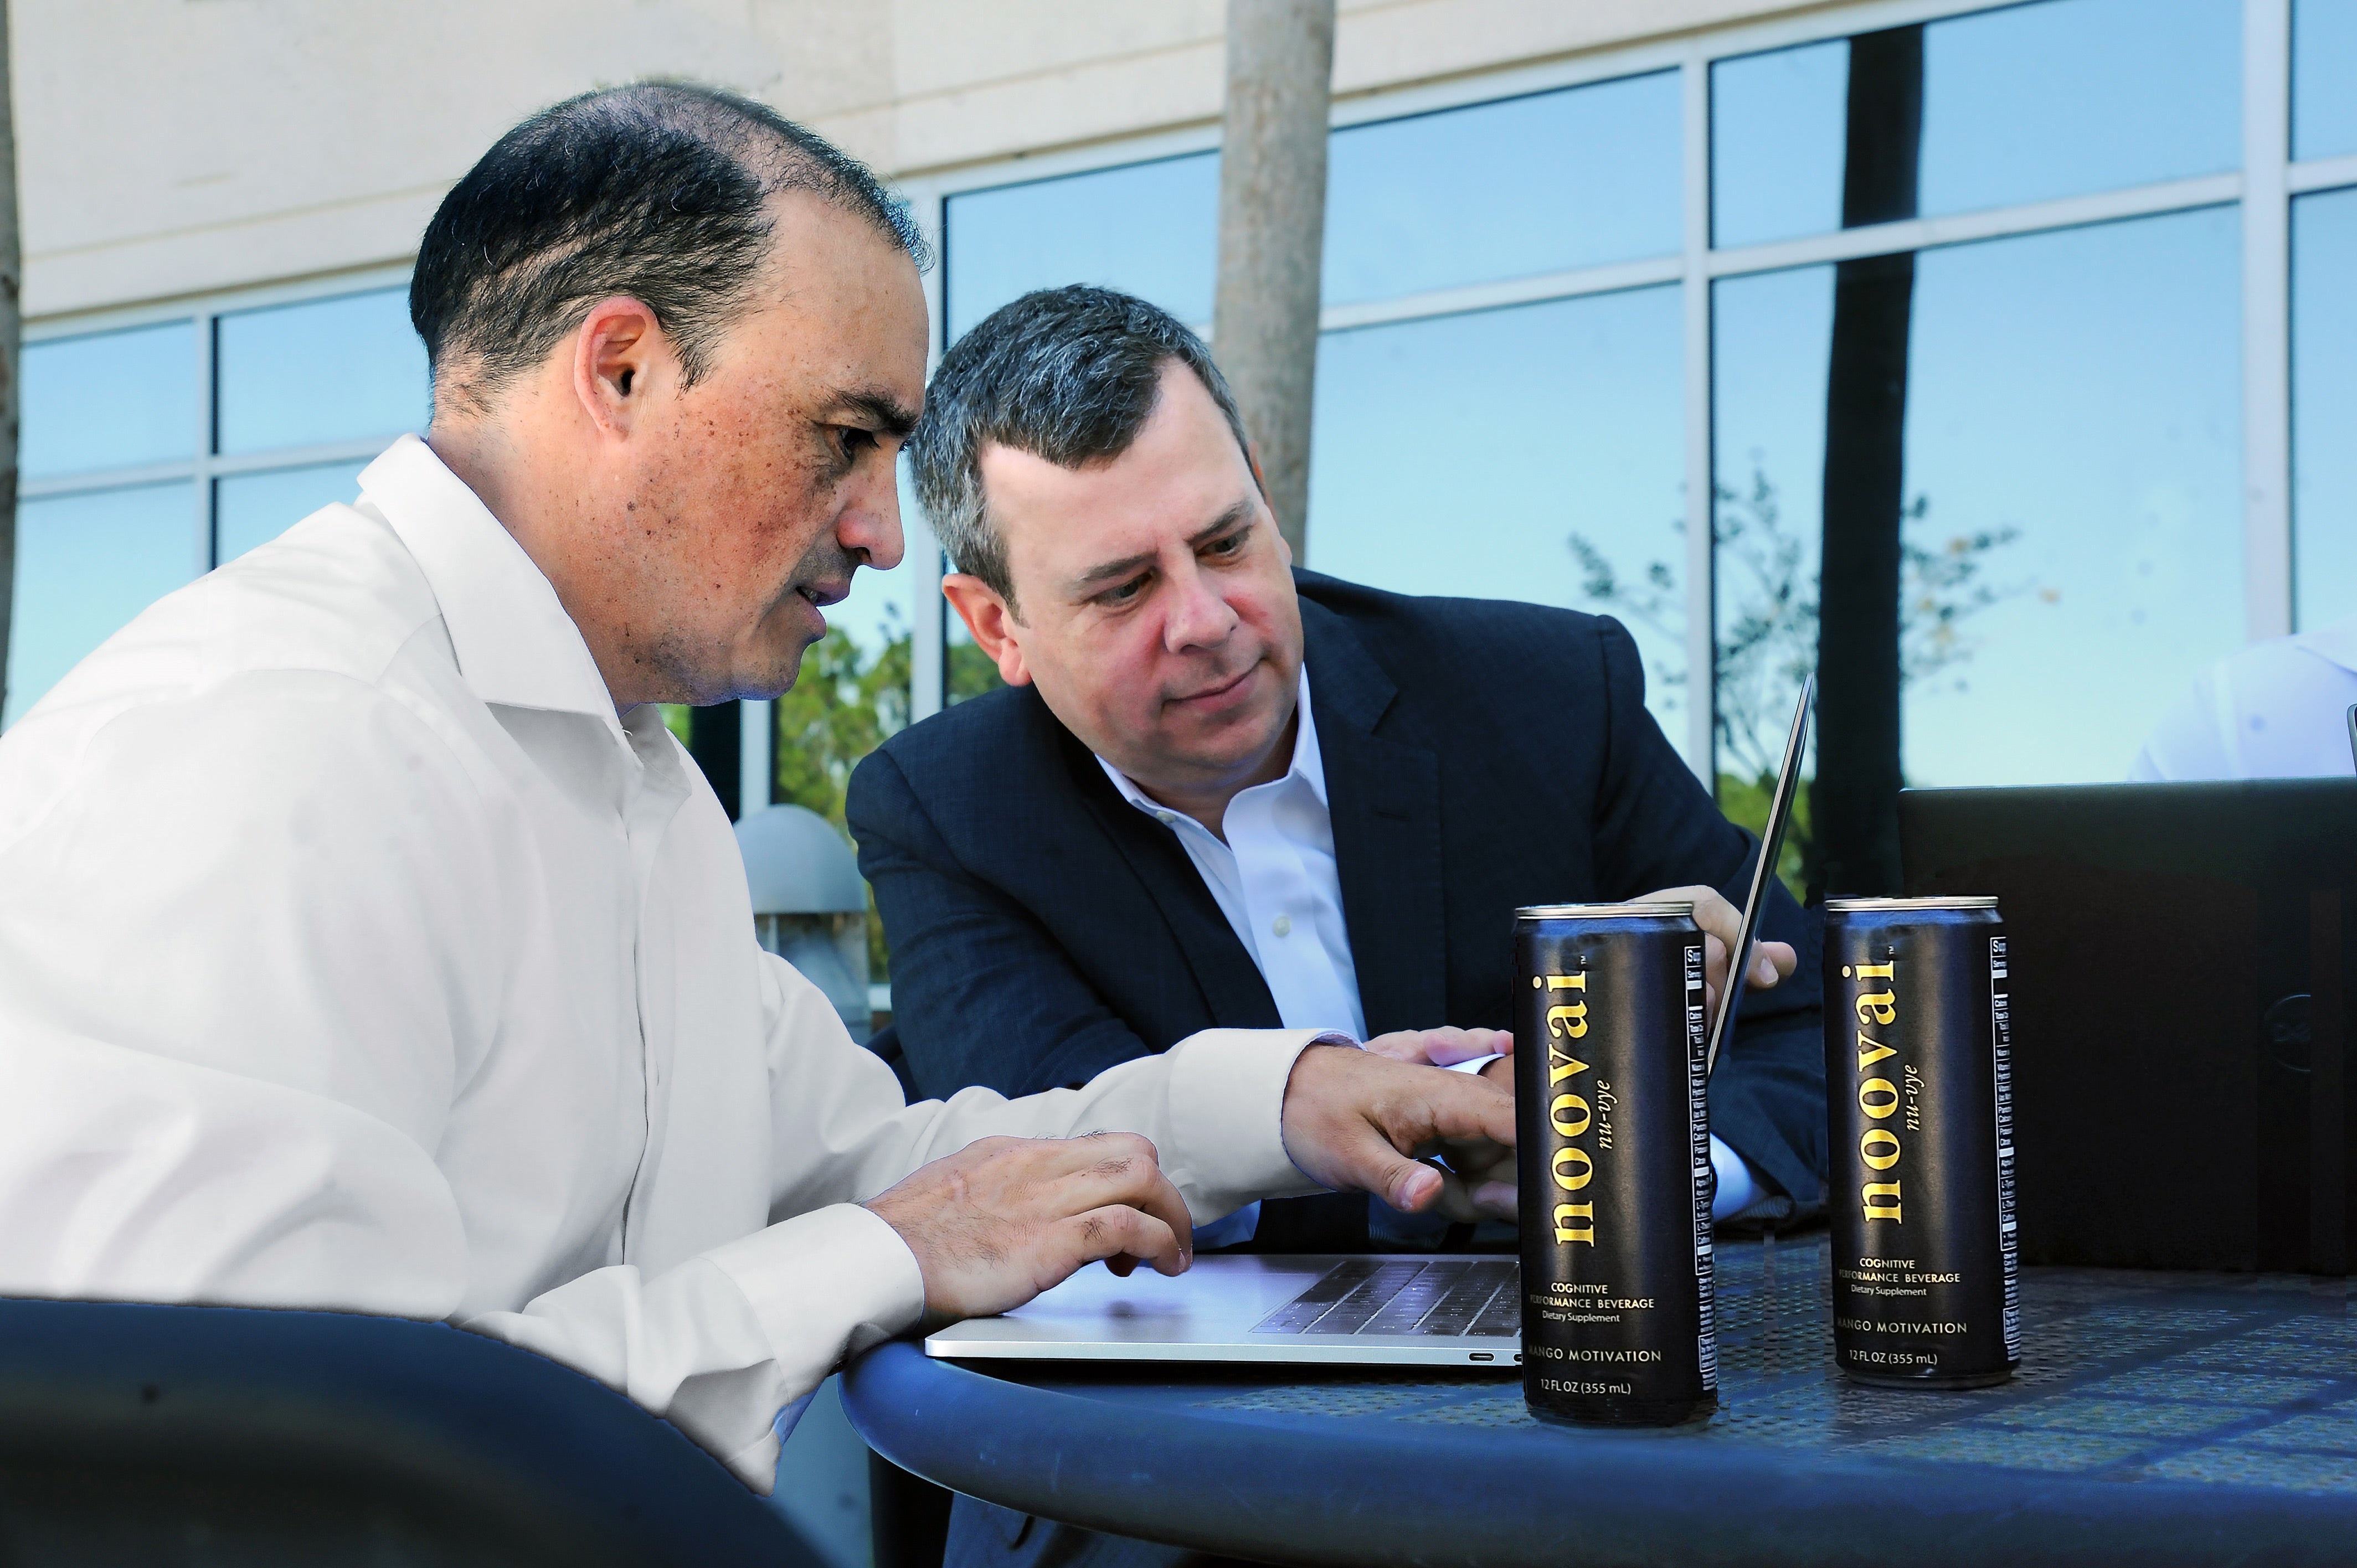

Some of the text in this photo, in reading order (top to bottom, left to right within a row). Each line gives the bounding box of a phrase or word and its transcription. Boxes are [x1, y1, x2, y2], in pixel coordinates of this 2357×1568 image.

[1842, 960, 1902, 1224] noovai
[1904, 1064, 1925, 1131] nu-vye
[1532, 970, 1594, 1247] noovai
[1597, 1079, 1618, 1150] nu-vye
[1859, 1257, 1915, 1269] COGNITIVE
[1905, 1273, 1960, 1283] BEVERAGE
[1551, 1282, 1608, 1294] COGNITIVE
[1851, 1284, 1927, 1297] Dietary Supplement
[1597, 1298, 1654, 1309] BEVERAGE
[1542, 1310, 1620, 1324] Dietary Supplement
[1876, 1321, 1967, 1334] MOTIVATION
[1568, 1349, 1661, 1362] MOTIVATION
[1849, 1349, 1937, 1365] 12 FL OZ (355 mL)
[1540, 1378, 1632, 1395] 12 FL OZ (355 mL)
